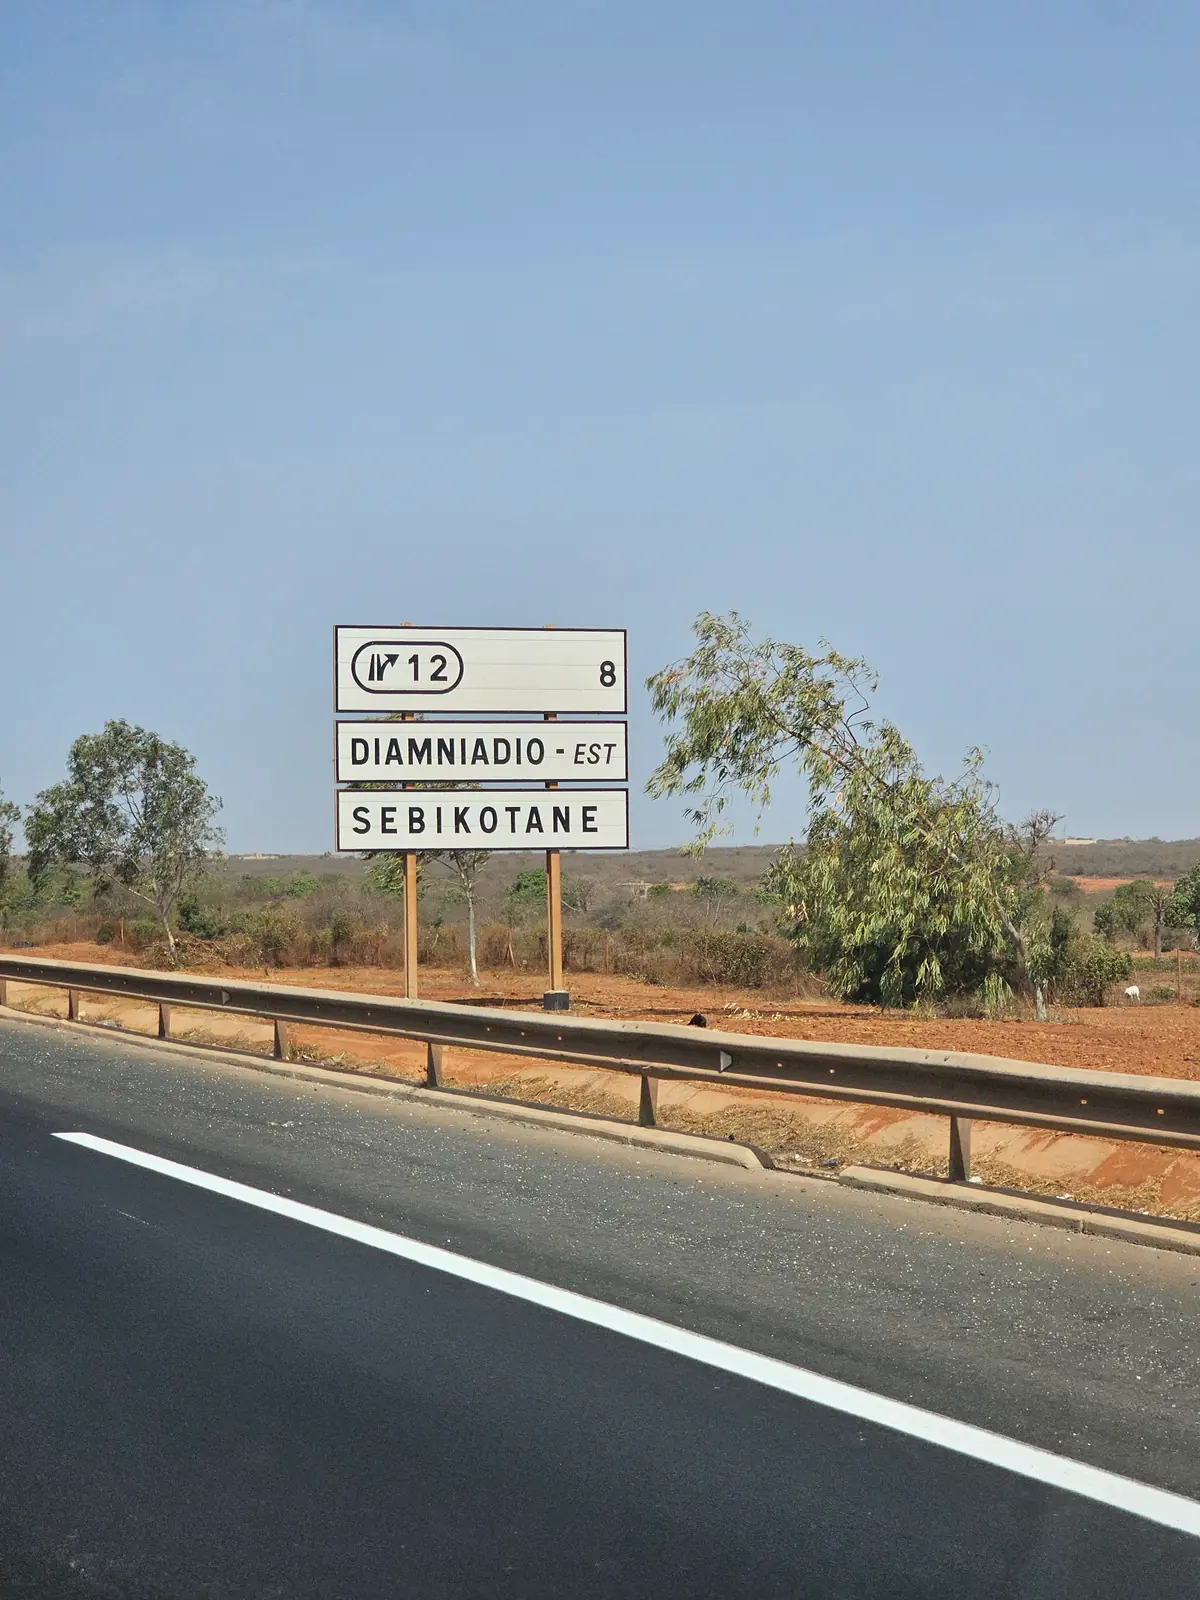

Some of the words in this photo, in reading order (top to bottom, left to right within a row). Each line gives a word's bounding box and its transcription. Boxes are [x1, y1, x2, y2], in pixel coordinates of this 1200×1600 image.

[408, 653, 448, 682] 12
[599, 660, 617, 688] 8
[351, 737, 545, 766] DIAMNIADIO
[573, 743, 617, 765] EST
[352, 805, 598, 835] SEBIKOTANE
